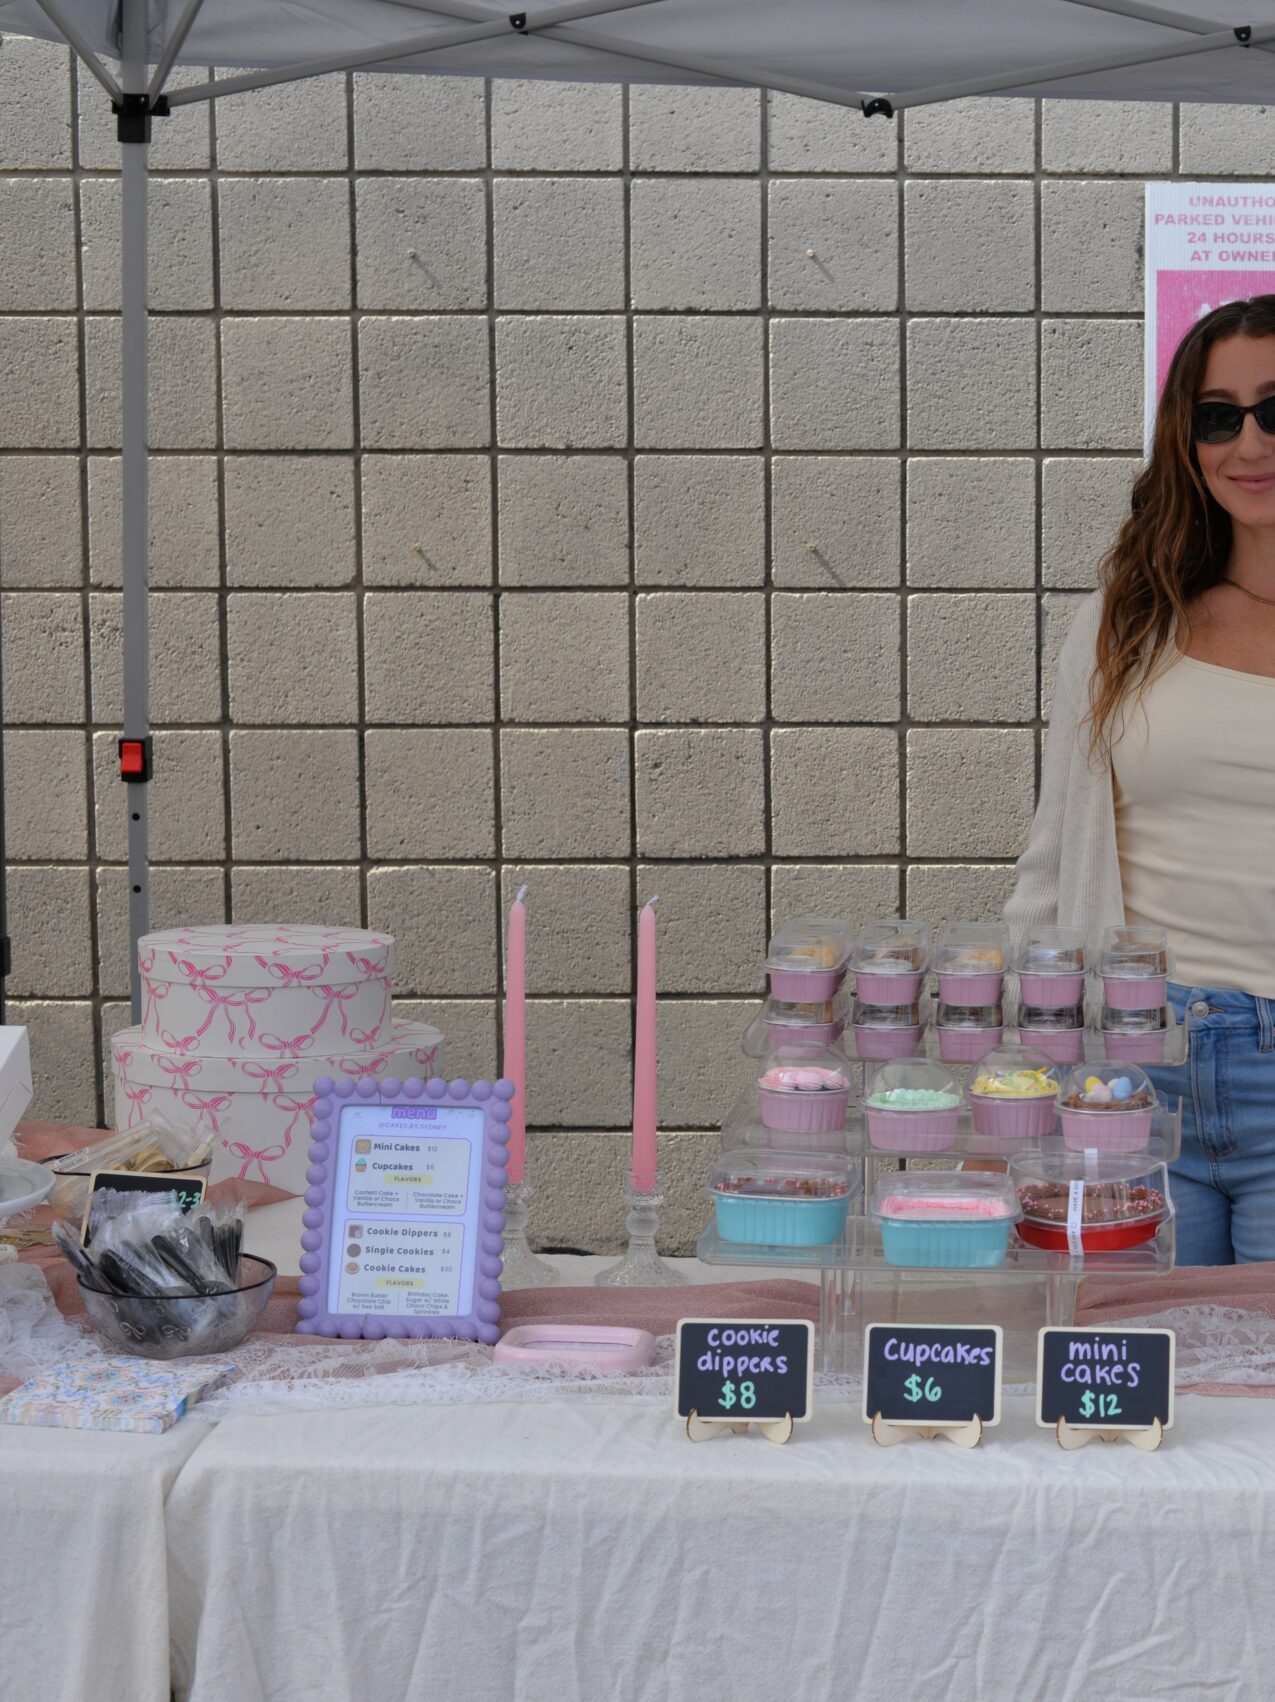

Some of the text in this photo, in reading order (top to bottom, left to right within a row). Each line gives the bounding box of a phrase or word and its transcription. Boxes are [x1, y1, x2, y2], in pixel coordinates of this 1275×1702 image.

[1154, 214, 1225, 226] PARKED
[1187, 232, 1208, 244] 24
[1213, 232, 1275, 245] HOURS
[1190, 250, 1213, 263] AT
[391, 1105, 438, 1121] menu
[373, 1142, 393, 1152] Mini
[394, 1143, 421, 1153] Cakes
[372, 1162, 414, 1172] Cupcakes
[367, 1227, 399, 1236] Cookie
[401, 1228, 439, 1238] Dippers
[365, 1245, 395, 1256] Single
[397, 1247, 435, 1256] Cookies
[363, 1264, 396, 1272] Cookie
[398, 1265, 426, 1274] Cakes
[707, 1325, 780, 1347] cookie
[1068, 1336, 1127, 1361] mini
[697, 1349, 788, 1377] dippers
[1060, 1363, 1141, 1388] cakes
[717, 1380, 757, 1410] $8
[903, 1373, 943, 1403] $6
[1078, 1389, 1123, 1418] $12
